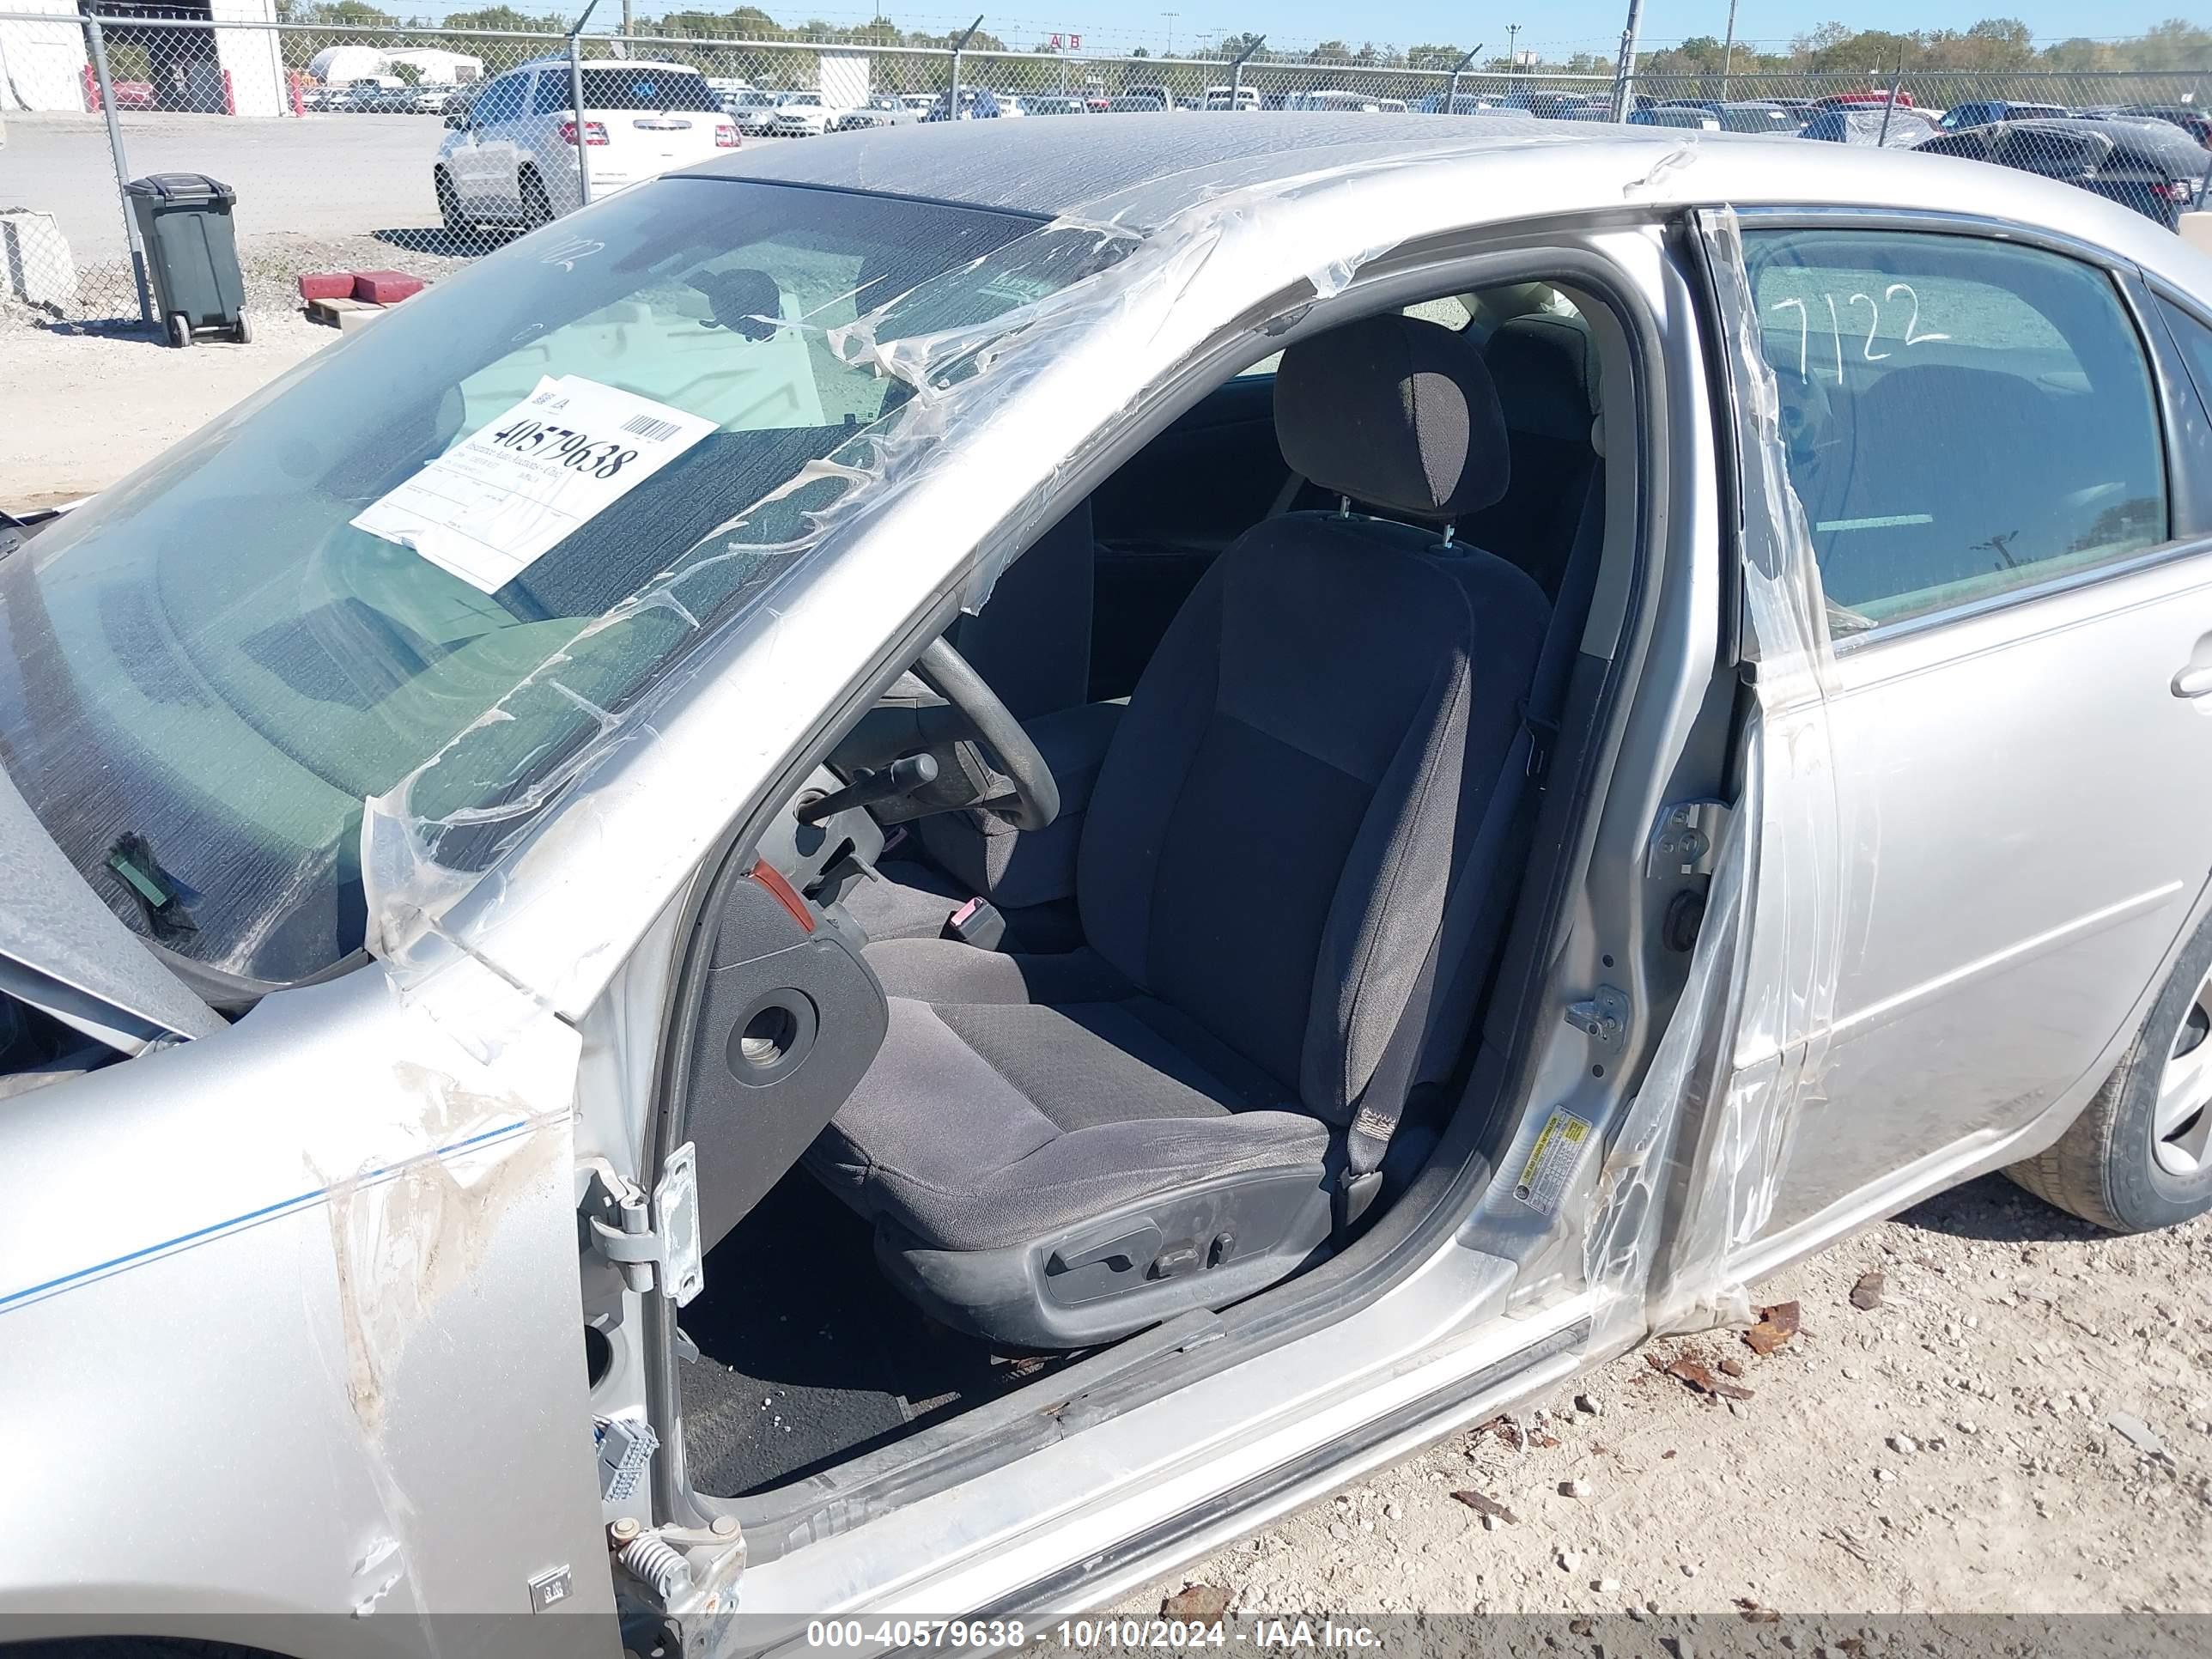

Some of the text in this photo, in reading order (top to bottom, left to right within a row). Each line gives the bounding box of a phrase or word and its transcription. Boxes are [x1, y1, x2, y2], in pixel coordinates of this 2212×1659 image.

[1050, 35, 1079, 49] A B
[1771, 283, 1951, 385] 7122
[493, 419, 638, 479] 40579638
